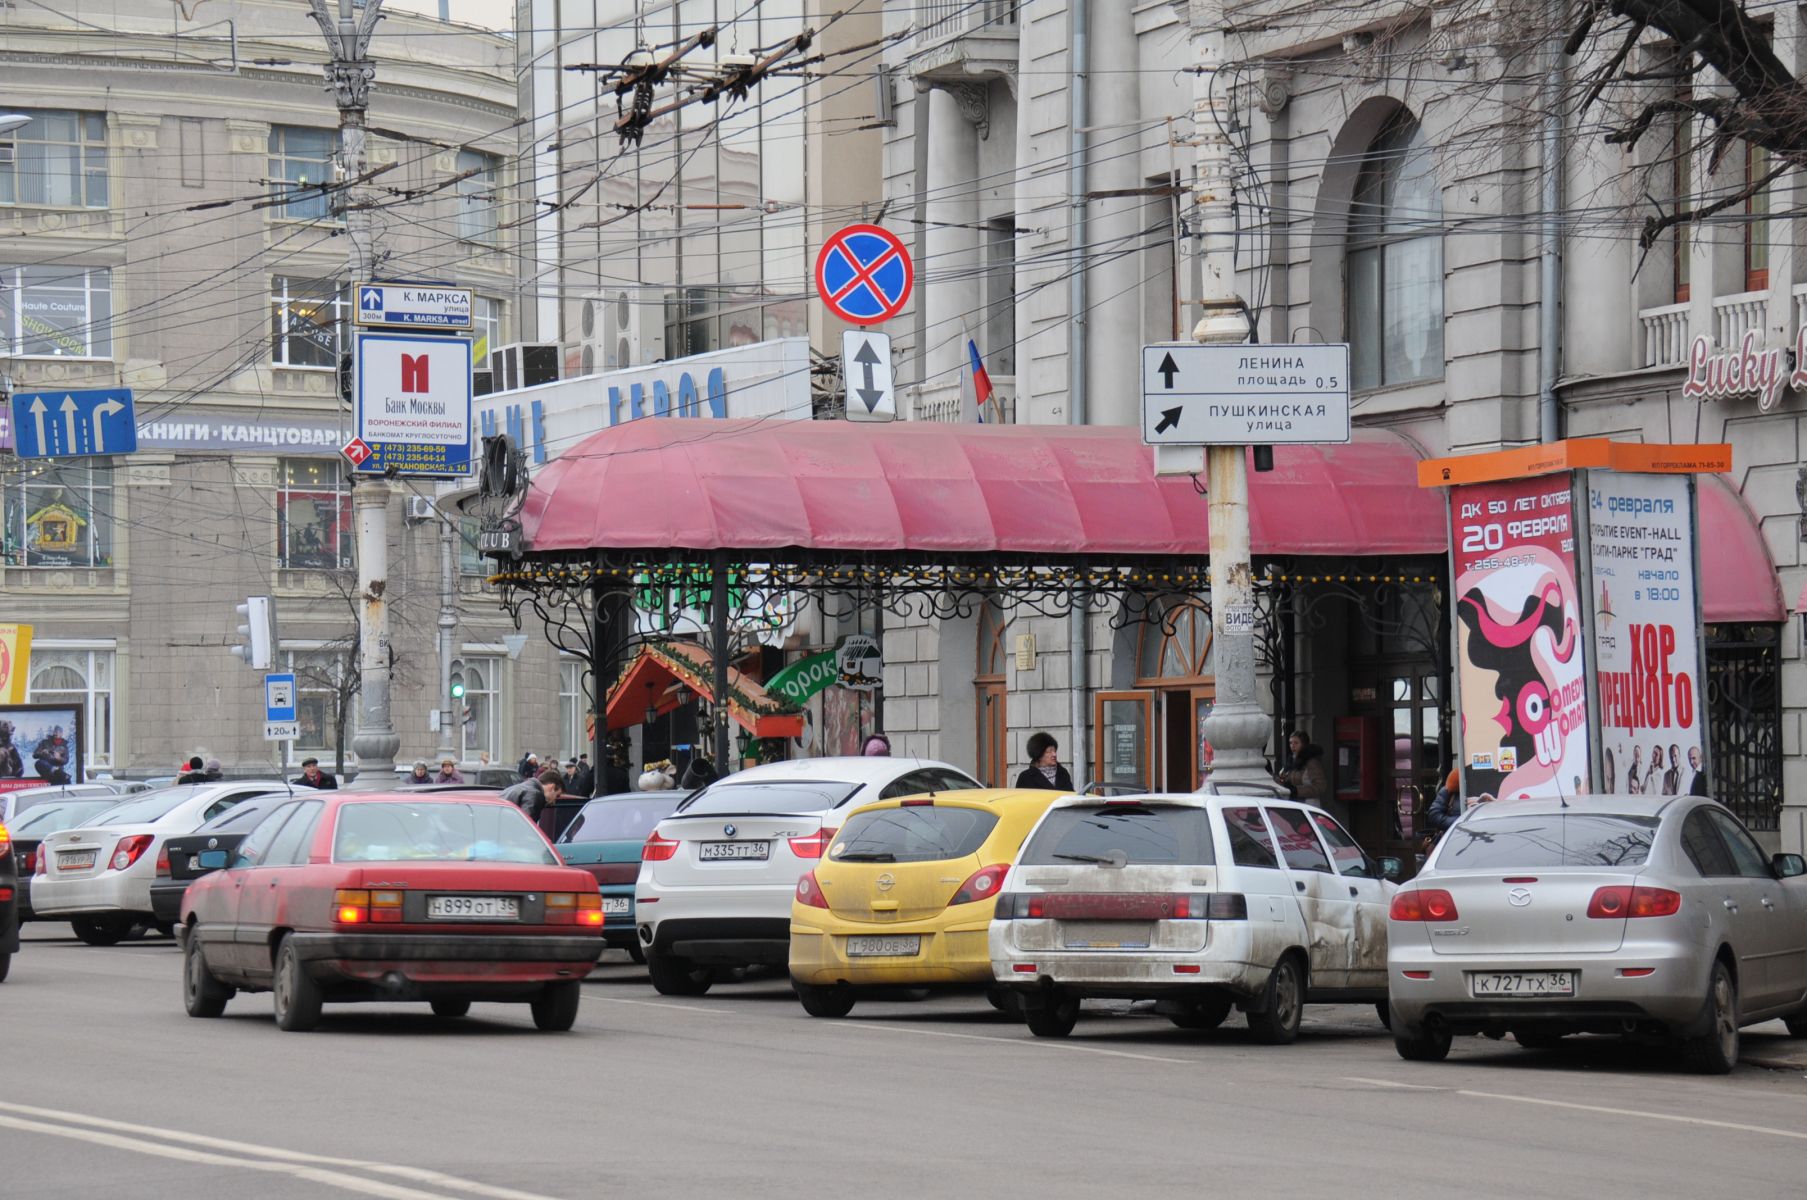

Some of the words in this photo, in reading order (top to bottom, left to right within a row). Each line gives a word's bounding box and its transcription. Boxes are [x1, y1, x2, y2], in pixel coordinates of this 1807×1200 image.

[404, 292, 414, 302] К.
[418, 292, 468, 304] МАРКСА
[22, 302, 48, 310] Haute
[50, 302, 86, 312] Couture
[414, 314, 448, 323] MARKSA
[1238, 357, 1305, 370] ЛЕНИНА
[1683, 328, 1783, 411] Lucky
[1238, 376, 1306, 386] площадь
[1316, 376, 1338, 390] 0,5
[385, 397, 408, 414] Банк
[410, 398, 446, 415] Москвы
[1209, 405, 1326, 417] ПУШКИНСКАЯ
[368, 419, 428, 428] ВОРОНЕЖСКИЙ
[429, 420, 462, 429] ФИЛИАЛ
[1247, 420, 1292, 433] улица
[137, 422, 209, 441] КНИГИ
[406, 432, 462, 440] КРУГЛОСУТОЧНО
[384, 444, 405, 452] (473)
[384, 453, 405, 462] (473)
[1462, 502, 1482, 520] ДК
[1488, 500, 1507, 514] 50
[1514, 497, 1537, 512] ЛЕТ
[1608, 496, 1674, 519] февраля
[1462, 523, 1504, 553] 20
[1507, 514, 1568, 539] ФЕВРАЛЯ
[1620, 526, 1682, 540] EVENT-HALL
[1640, 547, 1678, 562] "ГРАД"
[1638, 570, 1679, 580] начало
[1646, 588, 1680, 601] 18:00
[1226, 612, 1254, 626] ВИДЕ
[1629, 624, 1675, 675] ХОР
[704, 844, 750, 856] М335ТТ
[753, 843, 764, 852] 36
[432, 899, 493, 914] Н899ОТ
[500, 899, 514, 910] 36
[1481, 975, 1545, 991] К727ТХ
[1550, 973, 1566, 986] 36
